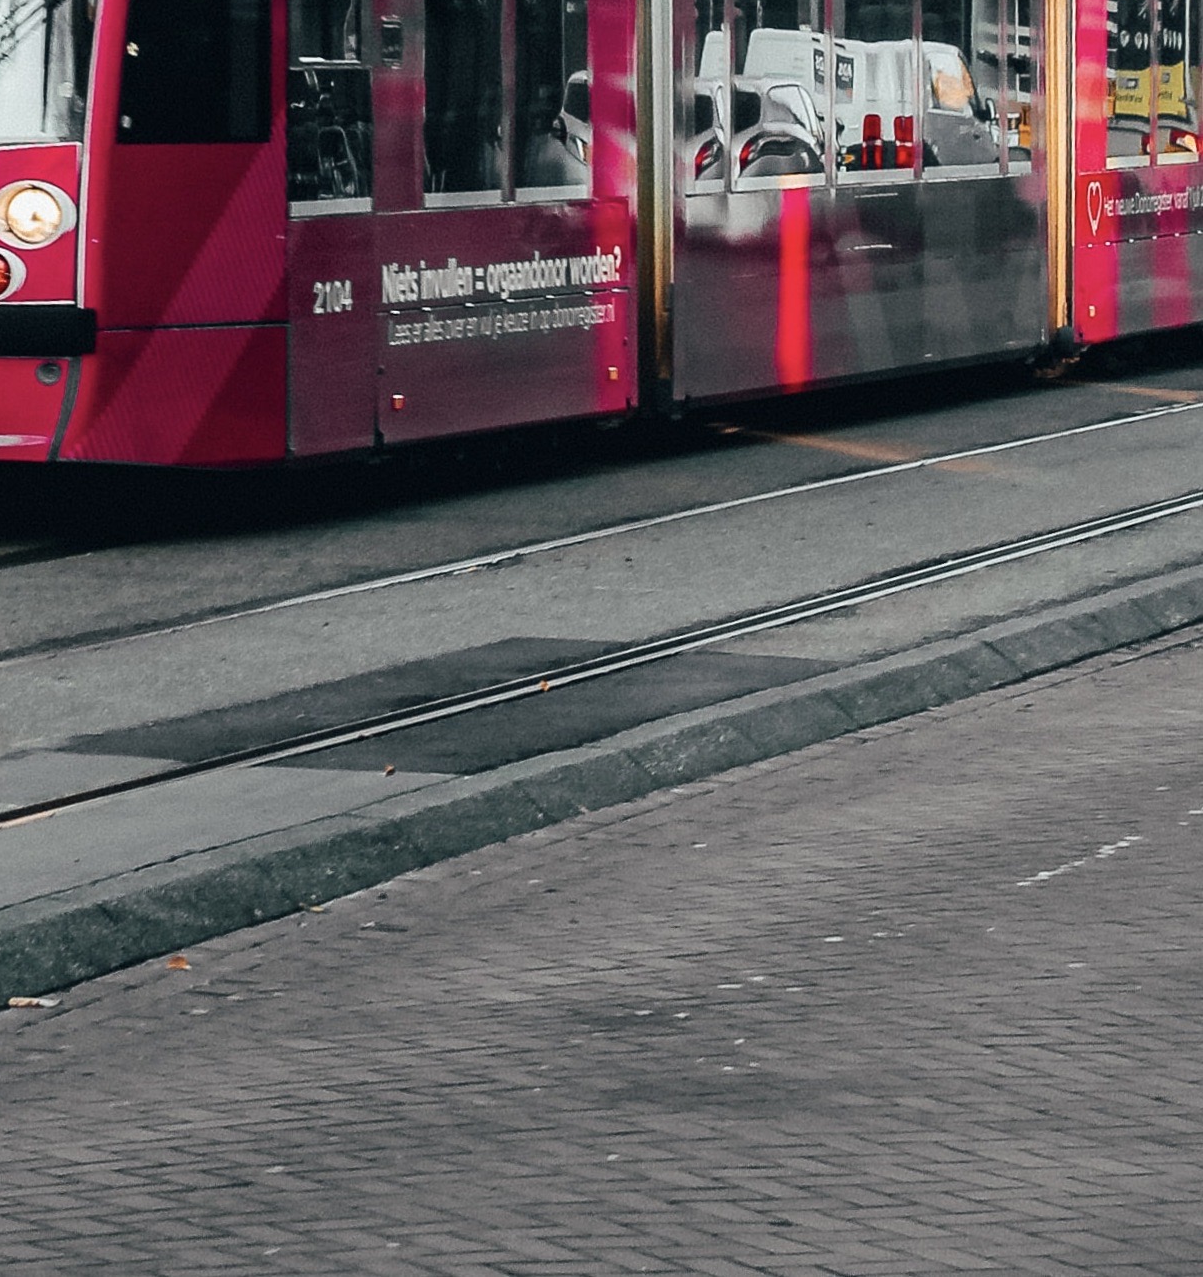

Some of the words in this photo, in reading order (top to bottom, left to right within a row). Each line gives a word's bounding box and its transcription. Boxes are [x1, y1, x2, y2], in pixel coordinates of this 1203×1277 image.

[313, 279, 354, 314] 2104
[382, 262, 419, 304] Niets
[475, 267, 484, 291] =
[486, 250, 568, 300] orgaandonor
[569, 245, 622, 286] worden?
